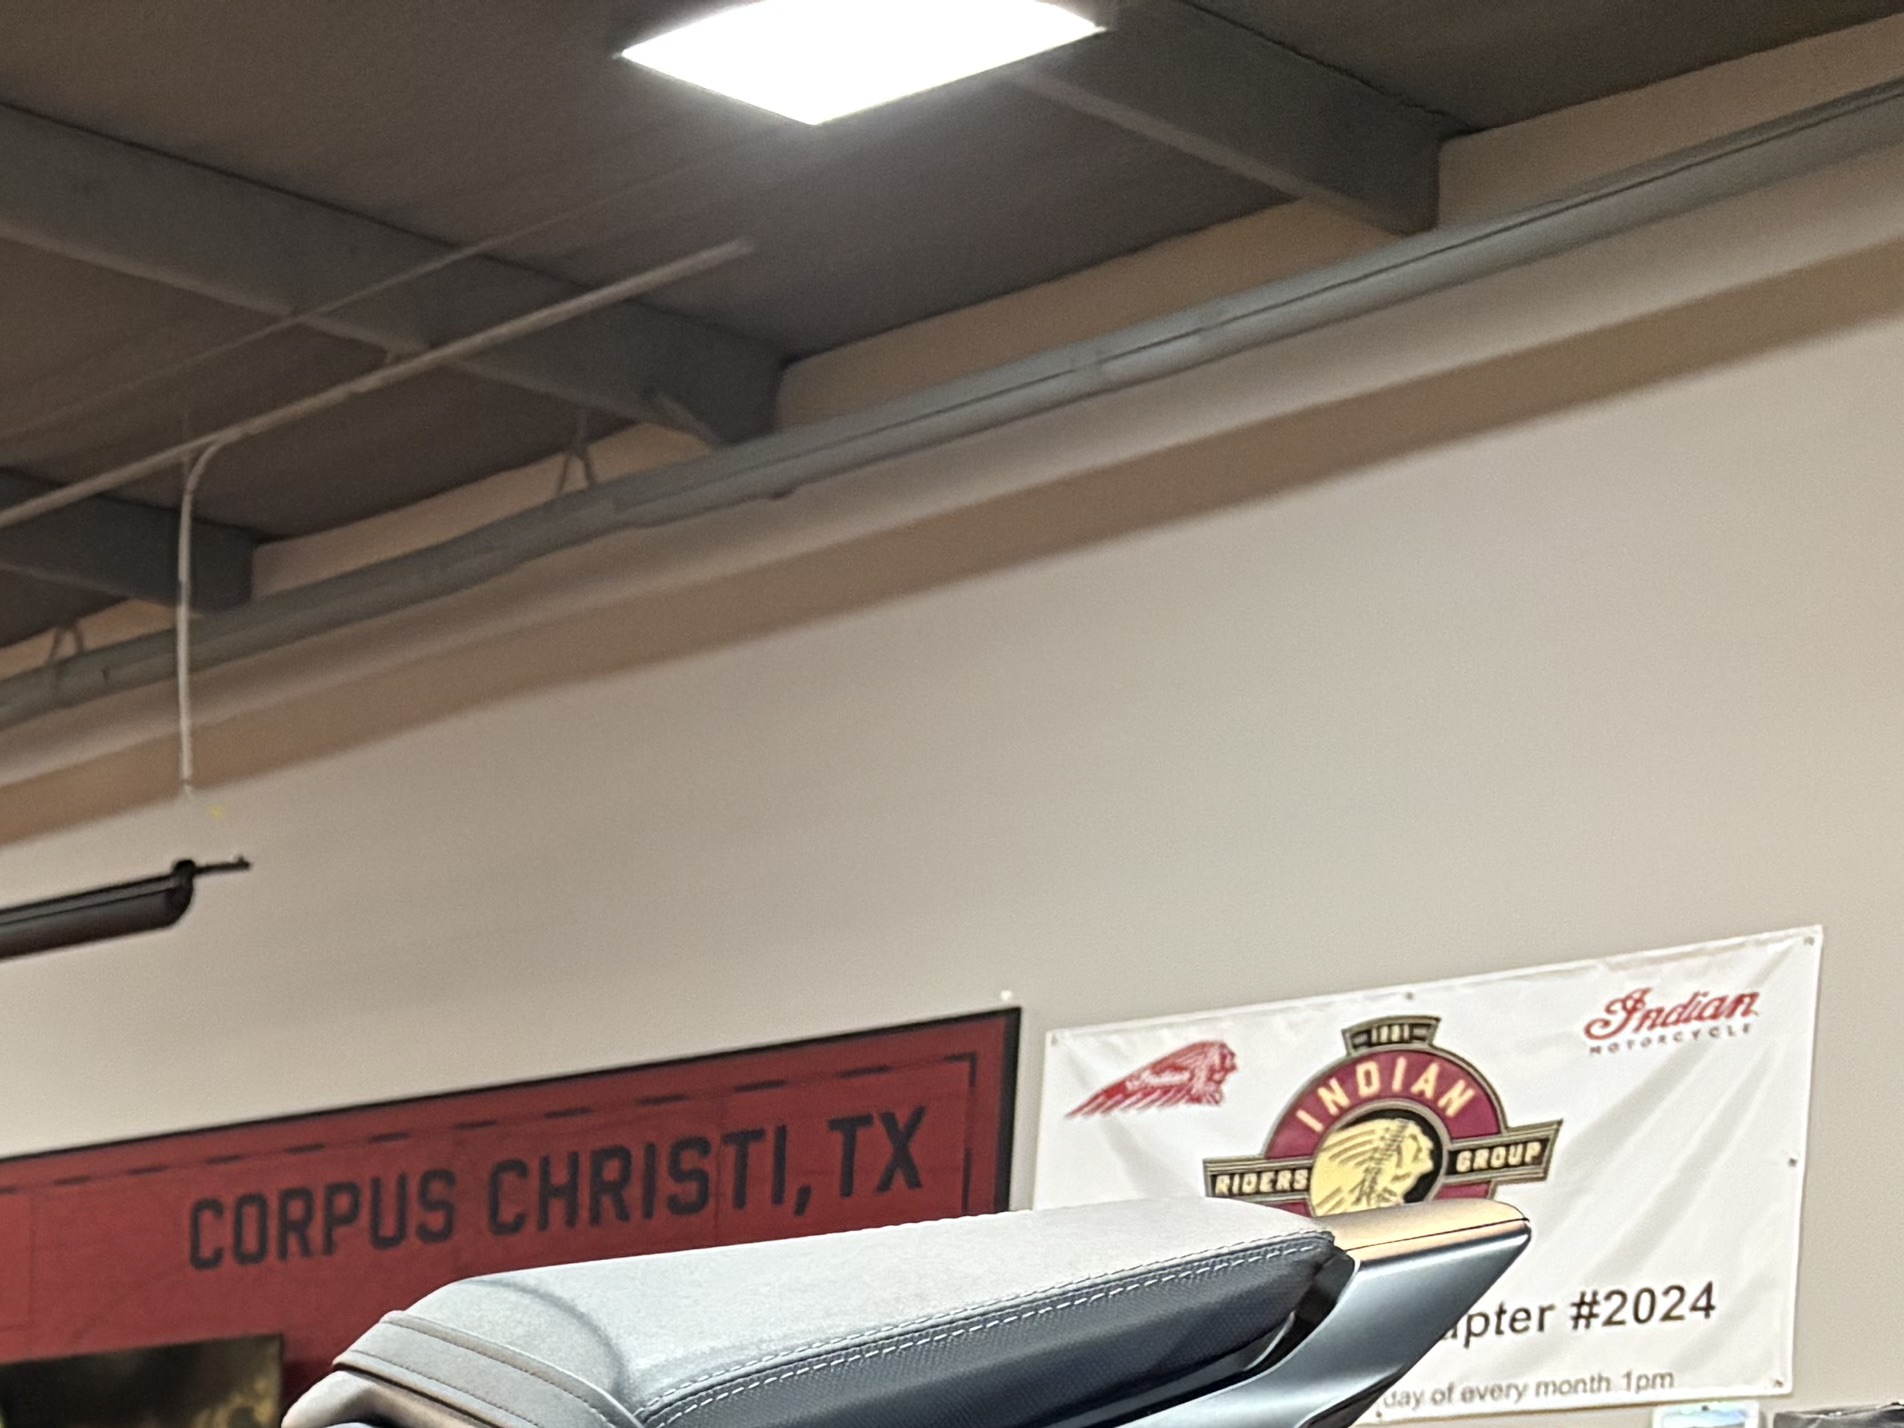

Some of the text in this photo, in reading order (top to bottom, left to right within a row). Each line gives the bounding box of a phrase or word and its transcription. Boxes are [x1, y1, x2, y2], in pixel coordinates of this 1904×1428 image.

[1584, 987, 1760, 1040] Indian
[1589, 1023, 1750, 1055] MOTORCYCLE
[1296, 1056, 1475, 1132] INDIAN
[191, 1106, 928, 1271] CORPUS CHRISTI, TX
[1215, 1141, 1542, 1195] RIDERS GROUP
[1441, 1280, 1716, 1349] pter #2024
[1430, 1383, 1453, 1406] of
[1461, 1381, 1530, 1407] every
[1534, 1371, 1612, 1398] month
[1621, 1369, 1674, 1395] 1pm
